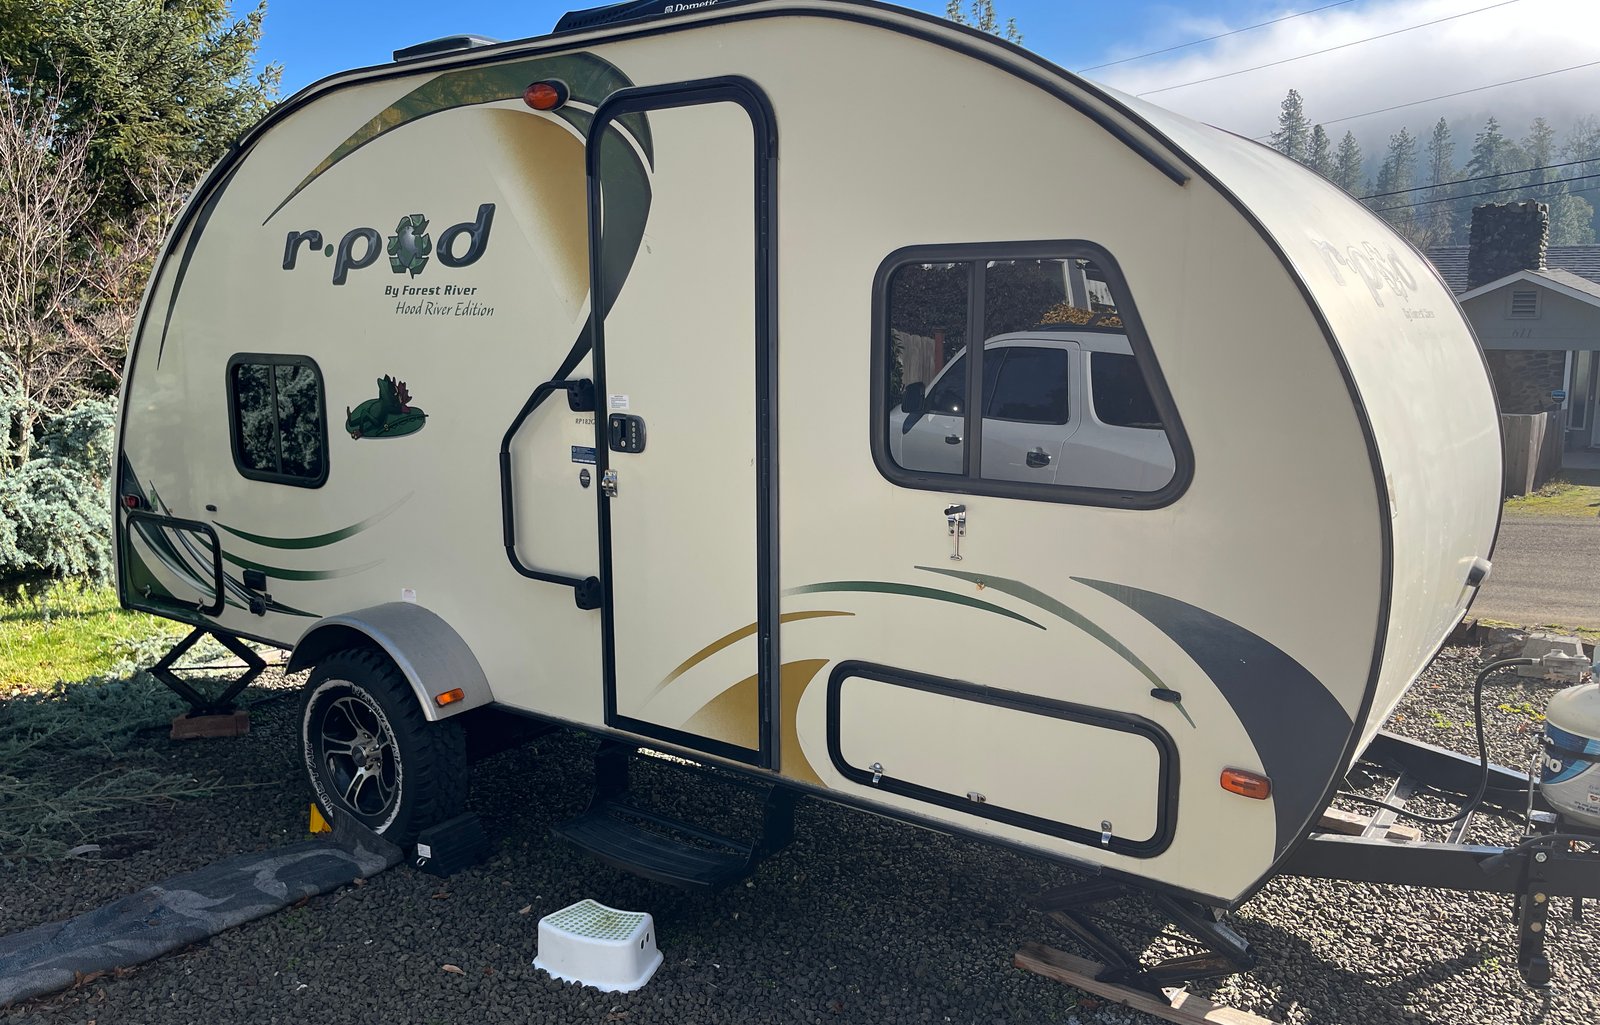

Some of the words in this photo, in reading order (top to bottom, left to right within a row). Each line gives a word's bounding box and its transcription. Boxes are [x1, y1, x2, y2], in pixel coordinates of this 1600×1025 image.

[384, 285, 399, 297] By
[402, 285, 441, 296] Forest
[444, 285, 477, 296] River
[395, 299, 424, 315] Hood
[425, 301, 453, 316] River
[454, 299, 495, 317] Edition
